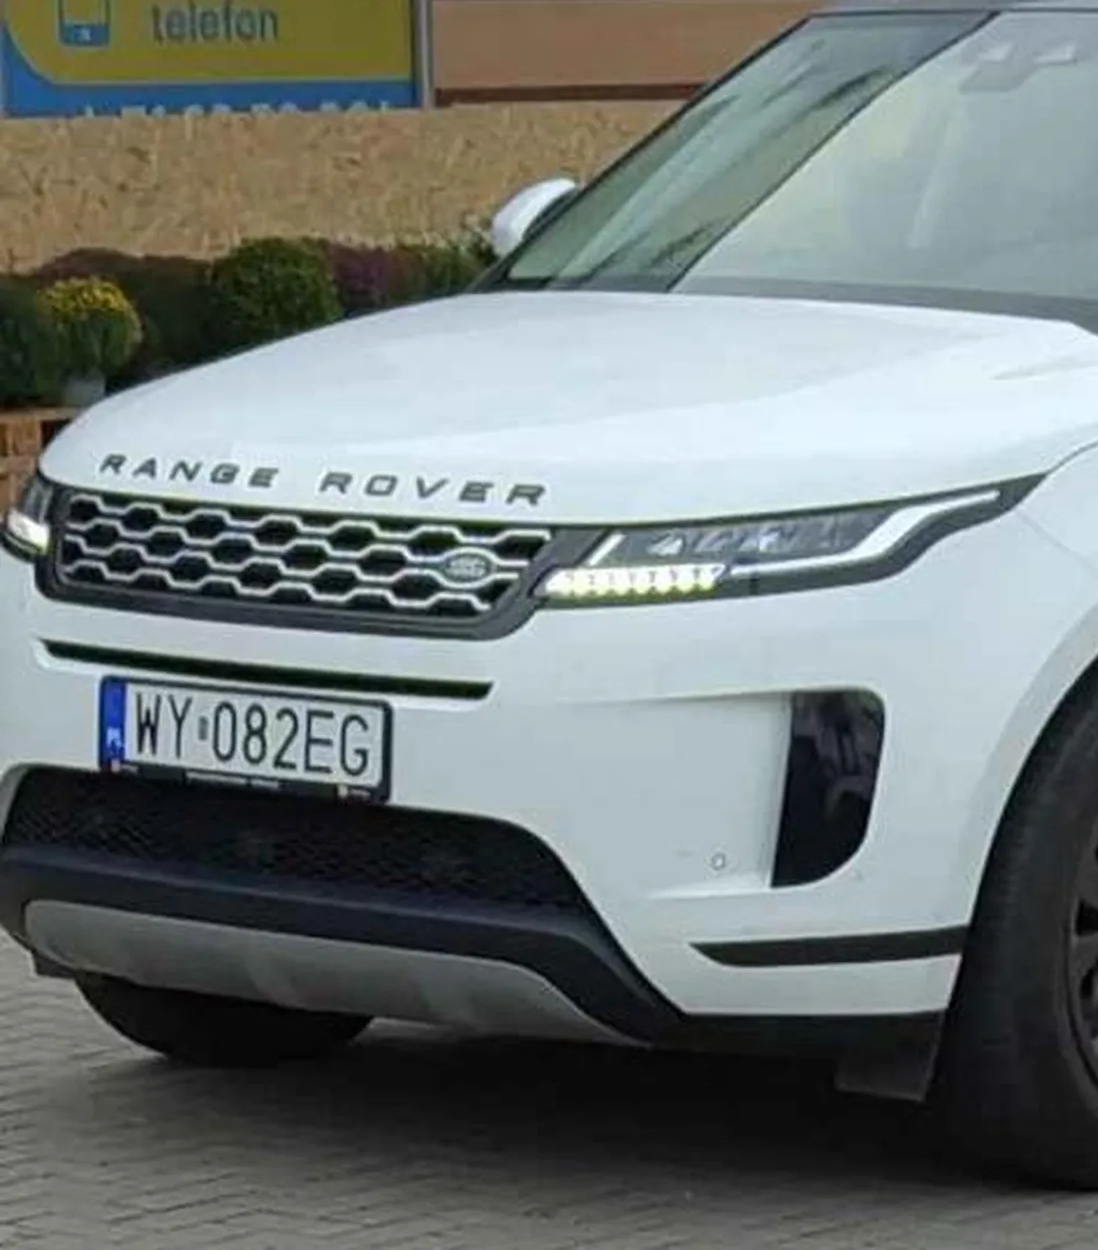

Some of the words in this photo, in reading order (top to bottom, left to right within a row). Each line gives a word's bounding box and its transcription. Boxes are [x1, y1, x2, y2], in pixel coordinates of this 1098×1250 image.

[152, 0, 279, 45] telefon
[100, 453, 280, 489] RANGE
[320, 471, 548, 507] ROVER
[135, 693, 193, 760] WY
[212, 700, 370, 777] 082EG
